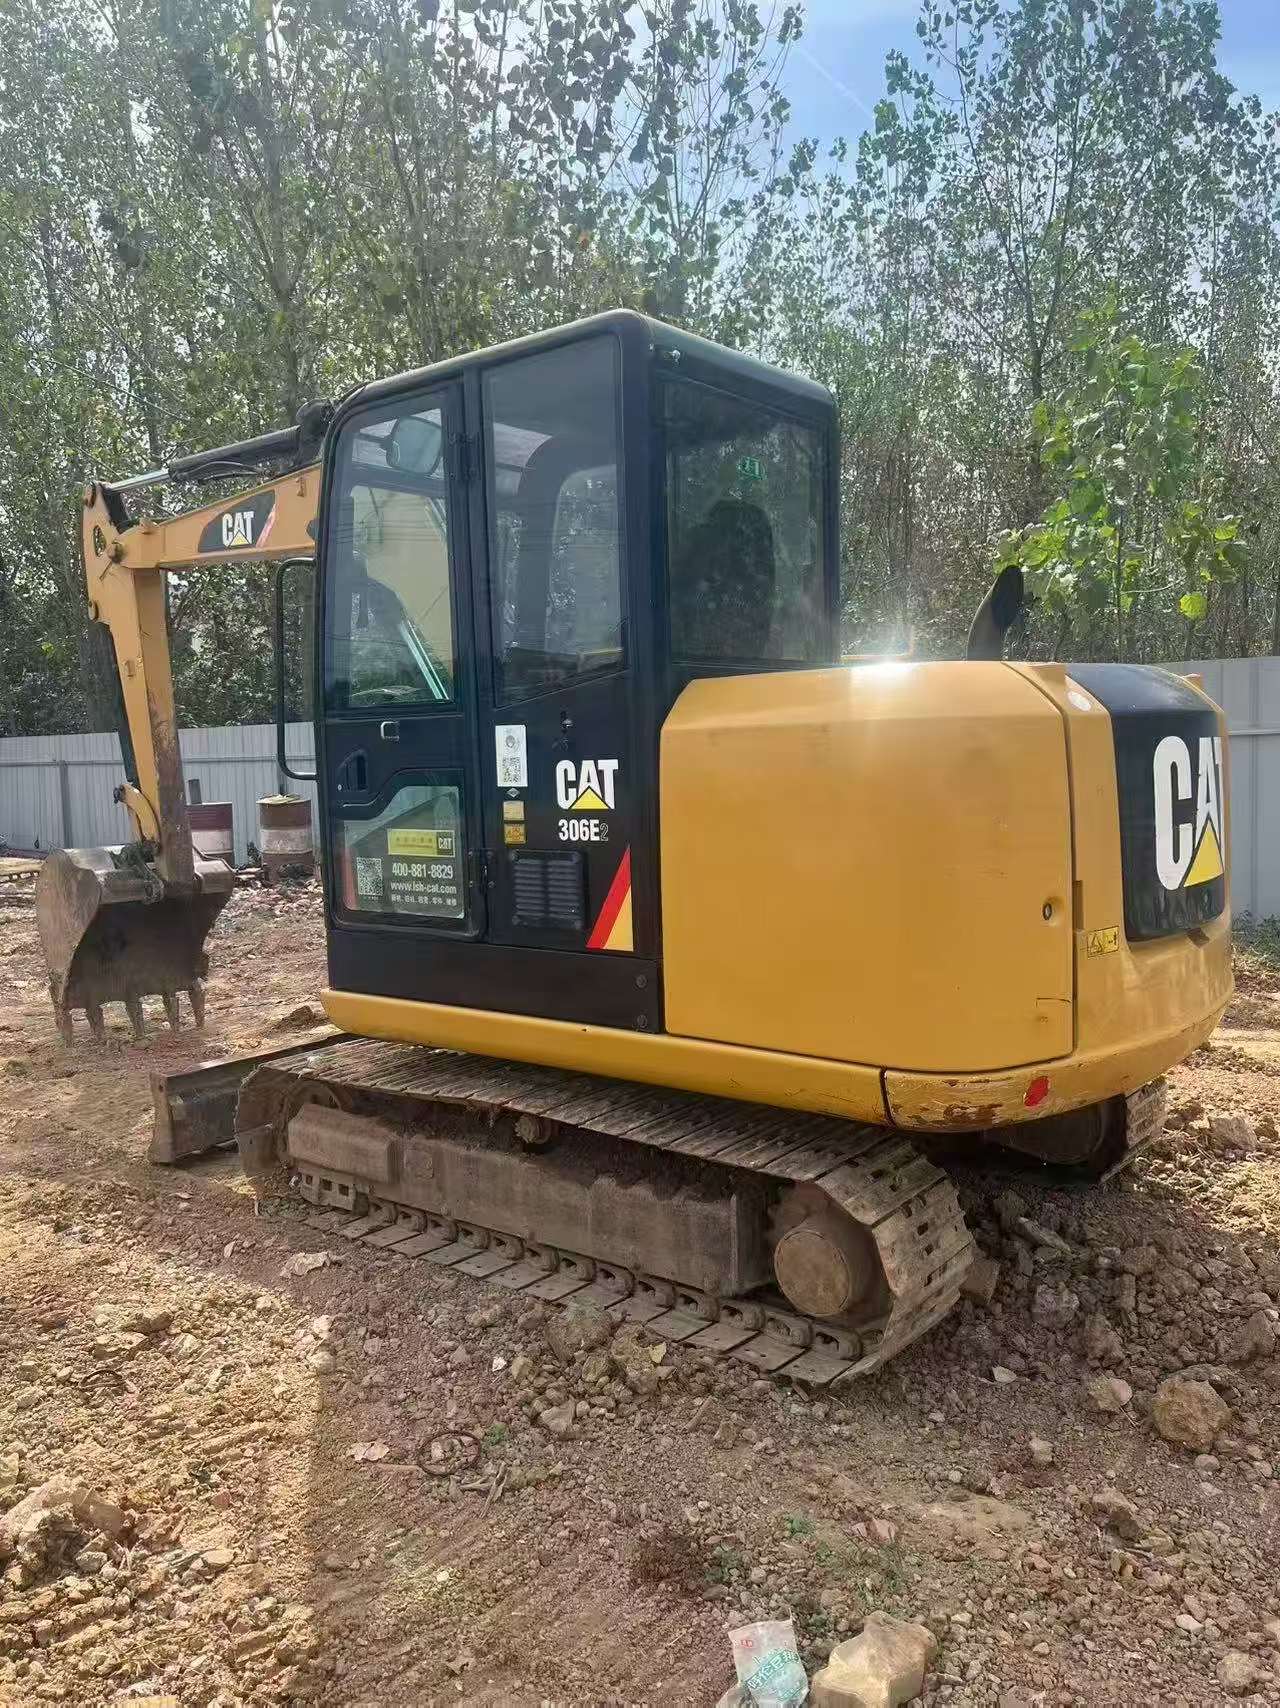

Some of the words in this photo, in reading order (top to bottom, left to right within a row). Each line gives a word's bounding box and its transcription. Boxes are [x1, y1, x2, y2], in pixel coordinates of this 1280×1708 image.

[222, 511, 254, 547] CAT
[556, 759, 618, 810] CAT
[438, 838, 453, 850] CAT
[392, 863, 453, 879] 400-881-8829
[391, 881, 457, 894] www.lsh-cat.com
